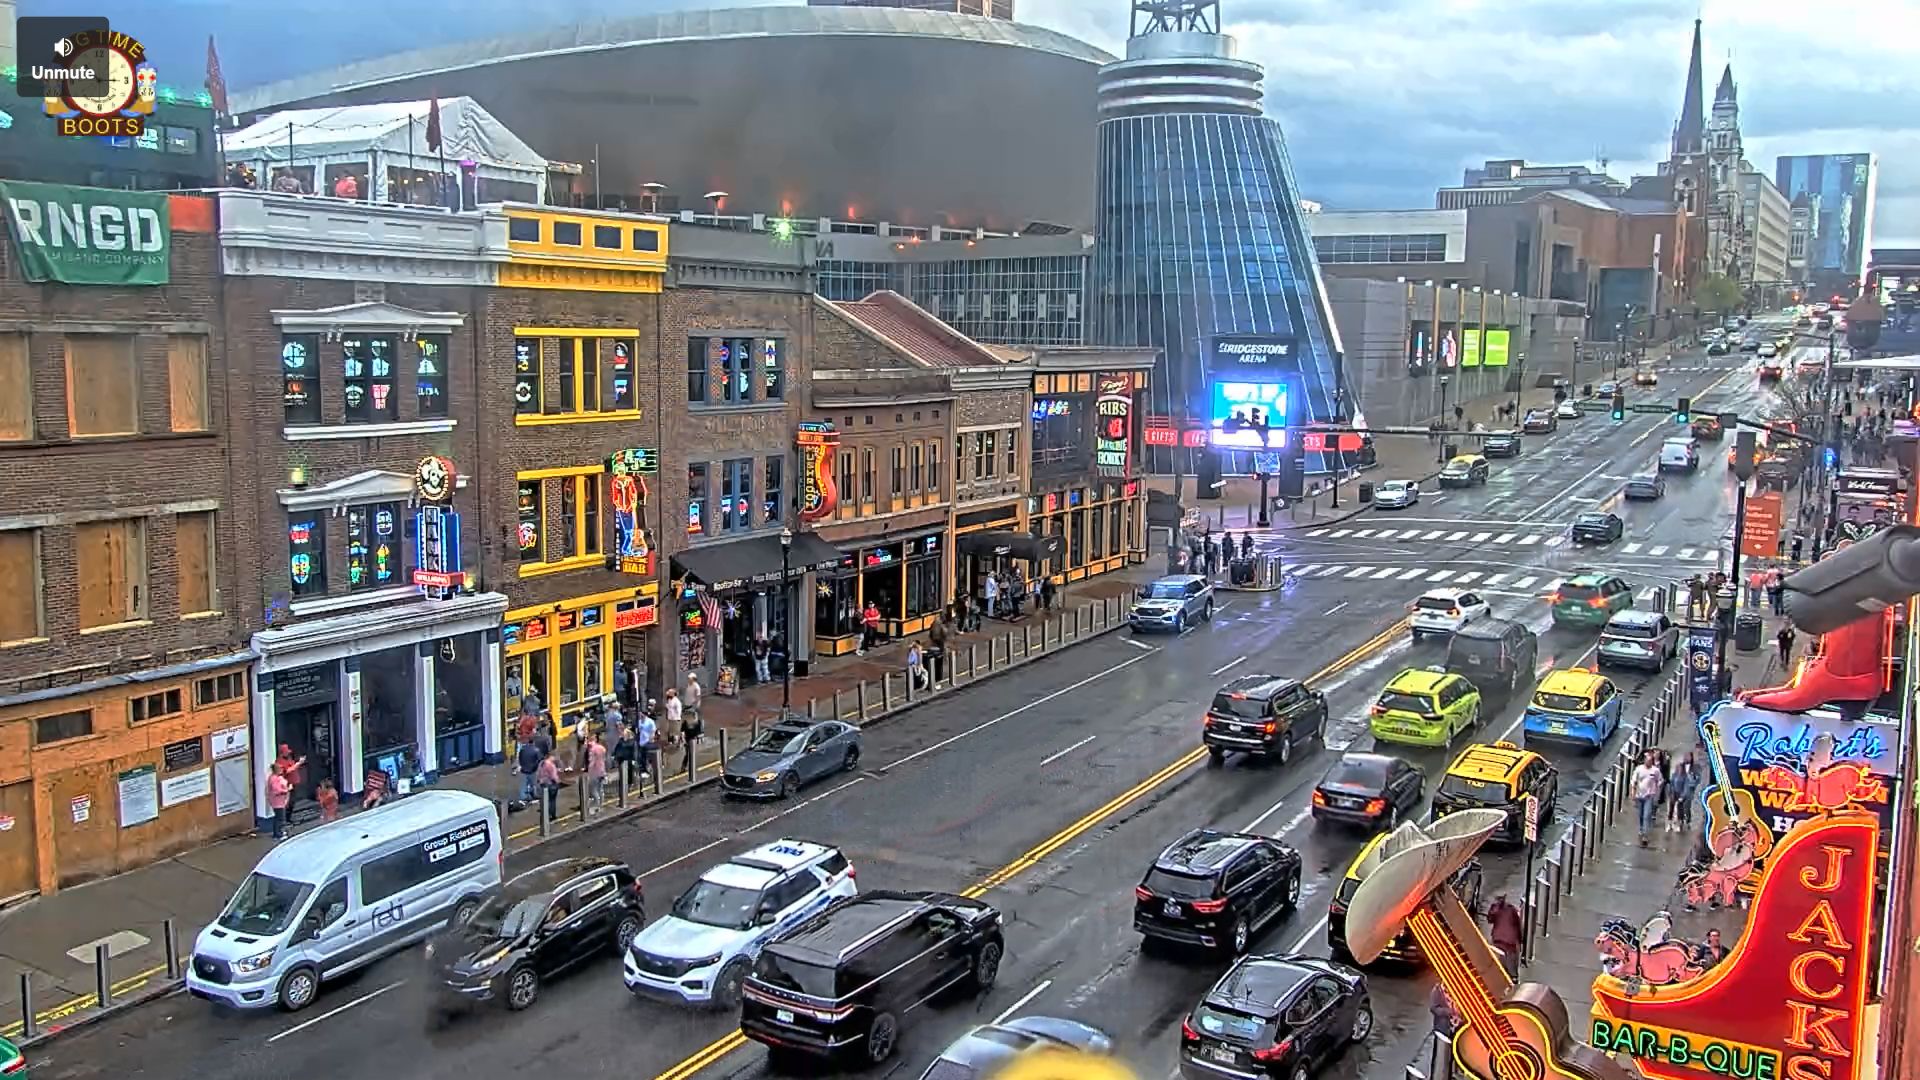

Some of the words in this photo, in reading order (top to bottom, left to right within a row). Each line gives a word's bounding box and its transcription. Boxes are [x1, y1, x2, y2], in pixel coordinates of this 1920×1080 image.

[8, 198, 163, 252] RNGD
[1218, 343, 1289, 355] BRIDGESTONE
[1238, 354, 1267, 363] ARENA
[1099, 401, 1127, 416] RIBS
[423, 838, 448, 852] Group
[449, 822, 487, 843] Rideshare
[1592, 1021, 1777, 1080] BAR-B-QUE
